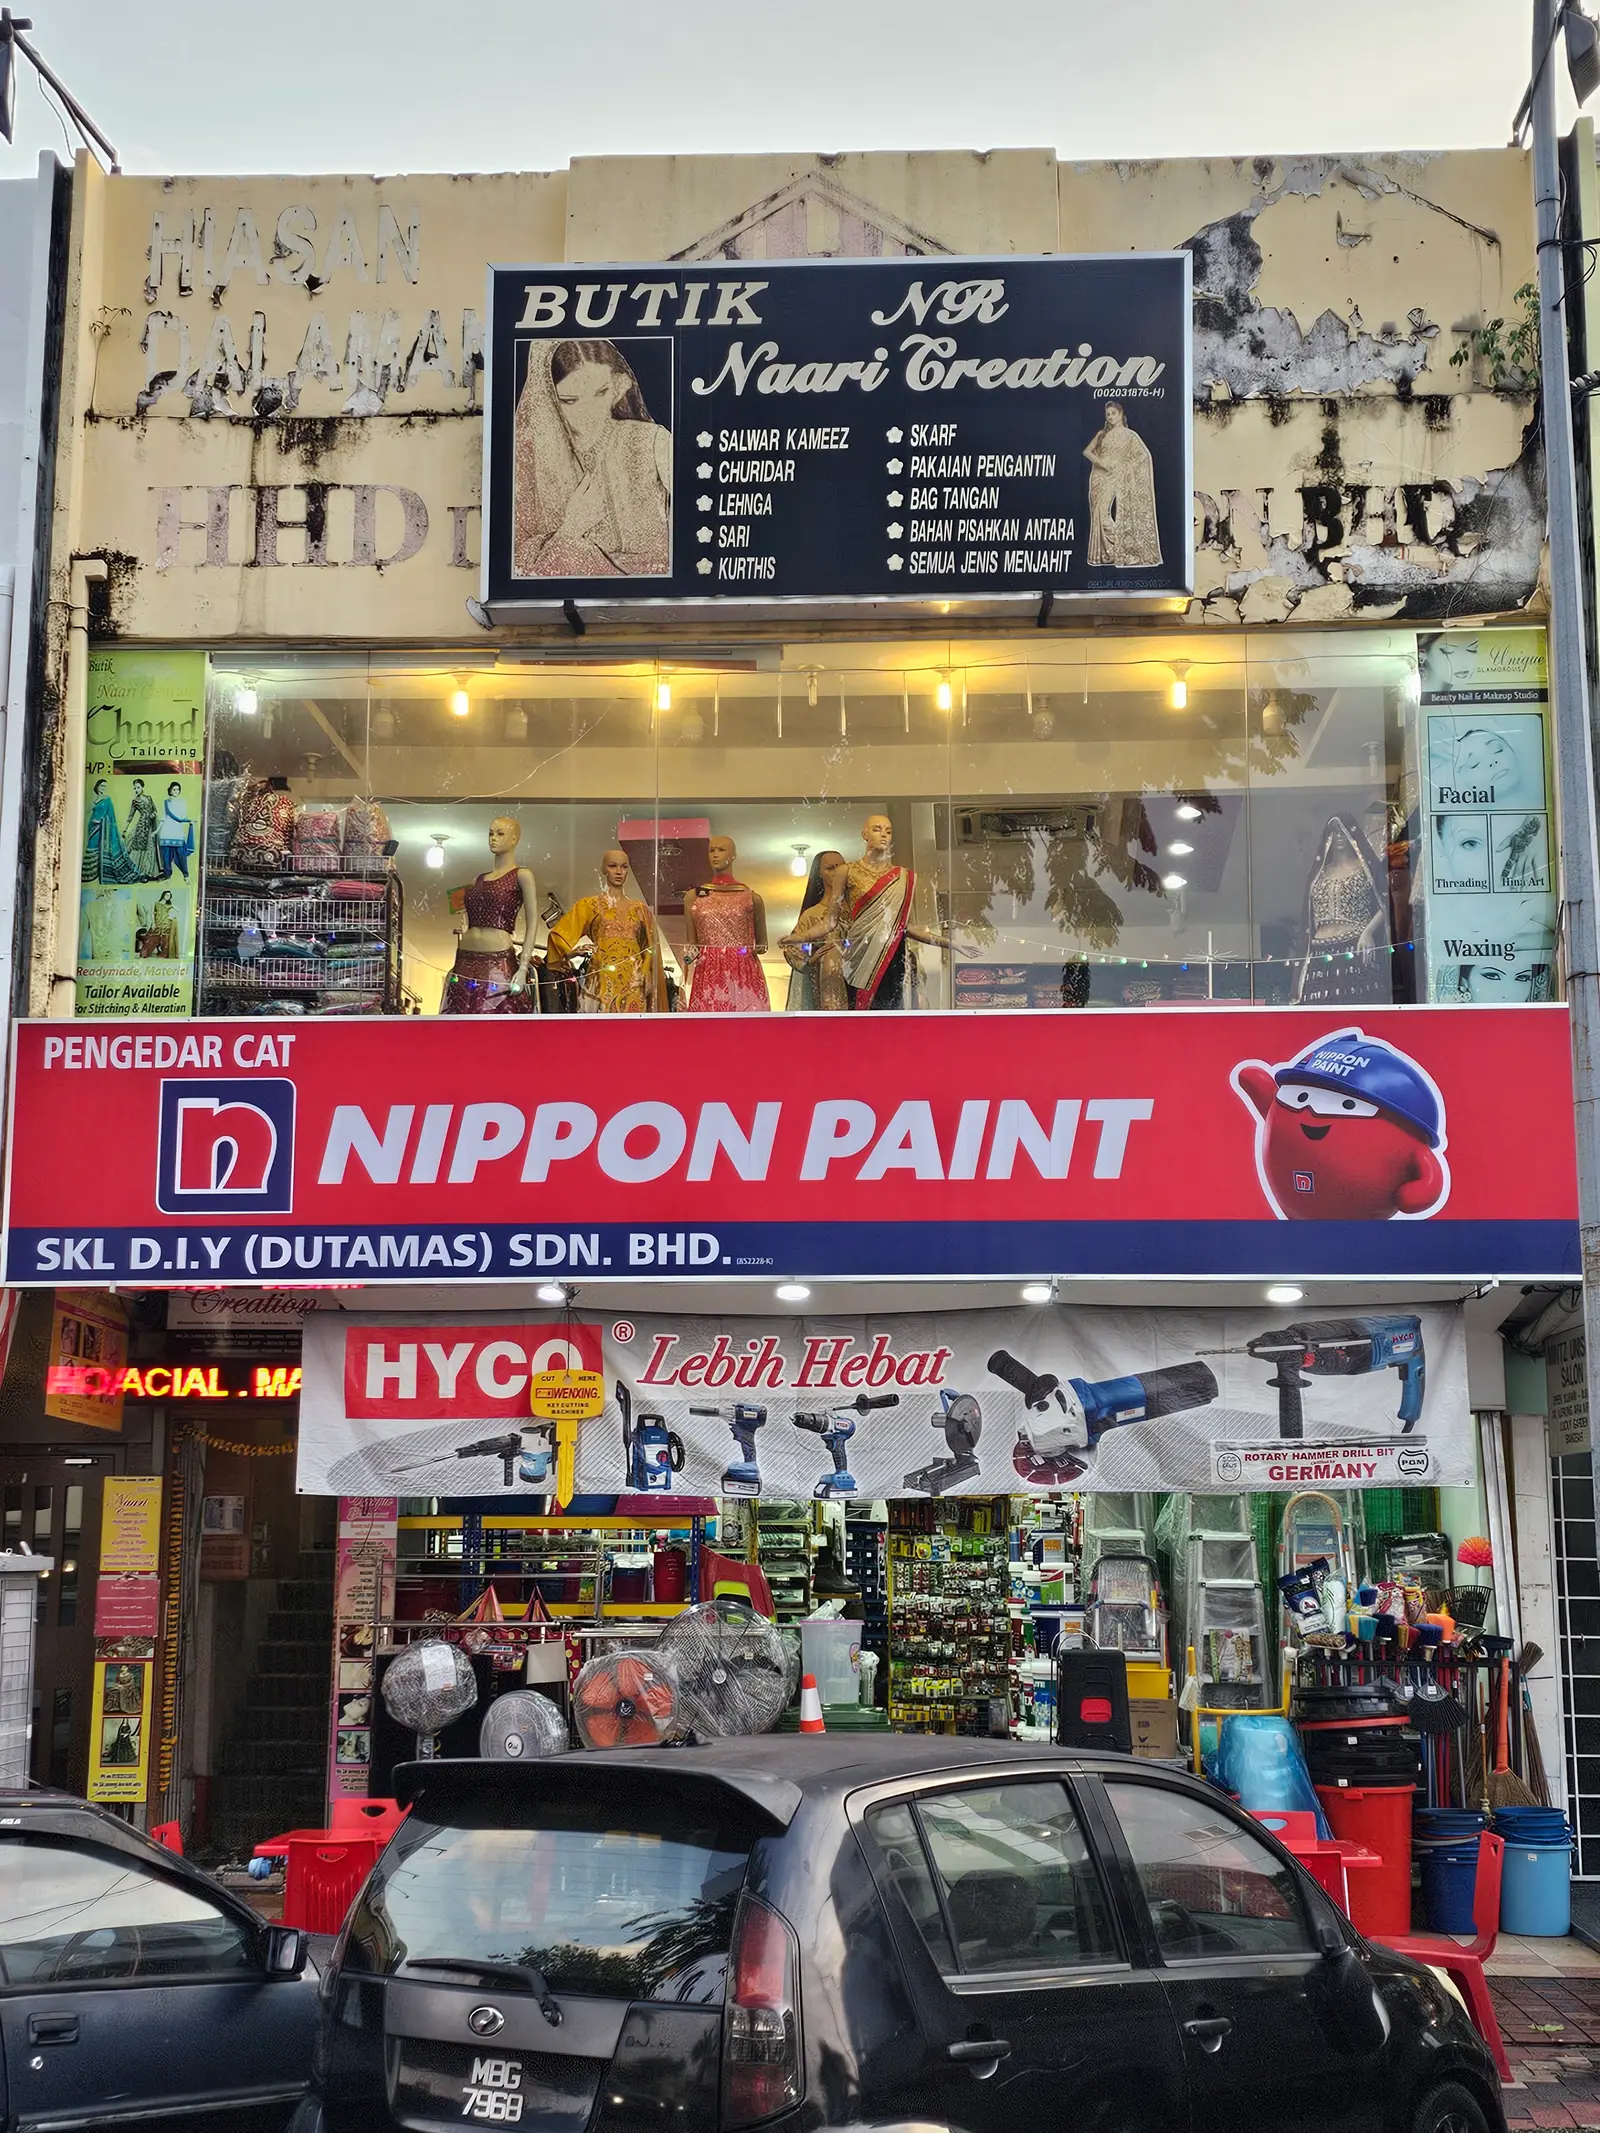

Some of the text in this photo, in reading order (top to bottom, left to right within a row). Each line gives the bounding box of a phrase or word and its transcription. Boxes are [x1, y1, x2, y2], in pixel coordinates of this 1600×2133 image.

[514, 281, 769, 329] BUTIK
[871, 278, 1010, 326] NR
[692, 333, 1166, 396] Naari Creation
[1093, 387, 1165, 399] (002031876-H)
[719, 427, 850, 452] SALWAR KAMEEZ
[910, 424, 957, 447] SKARF
[719, 460, 795, 483] CHURIDAR
[910, 454, 1056, 478] PAKAIAN PENGANTIN
[719, 493, 773, 516] LEHNGA
[910, 487, 999, 510] BAG TANGAN
[719, 525, 750, 548] SARI
[910, 518, 1075, 542] BAHAN PISAHKAN ANTARA
[719, 557, 776, 580] KURTHIS
[909, 550, 1072, 574] SEMUA JENIS MENJAHIT
[1490, 644, 1546, 673] Unique
[1431, 691, 1539, 703] Beauty Nail & Makeup Studio
[131, 746, 197, 758] Tailoring
[1438, 785, 1496, 804] Facial
[1435, 878, 1488, 890] Threading
[1528, 877, 1545, 887] Art
[1443, 939, 1516, 961] Waxing
[85, 984, 180, 999] Tailor Available
[88, 1003, 130, 1016] Stitching
[132, 1003, 140, 1013] &
[44, 1035, 296, 1069] PENGEDAR CAT
[1314, 1050, 1371, 1068] NIPPON
[1311, 1059, 1355, 1077] PAINT
[317, 1098, 1155, 1185] NIPPON PAINT
[36, 1237, 115, 1270] SKL
[129, 1236, 231, 1270] D.I.Y
[244, 1231, 494, 1275] (DUTAMAS)
[508, 1233, 612, 1267] SDN.
[628, 1232, 732, 1266] BHD.
[637, 1335, 952, 1389] Lebih Hebat
[1244, 1448, 1395, 1462] ROTARY HAMMER DRILL BIT
[1401, 1459, 1426, 1467] PGM
[1268, 1462, 1378, 1482] GERMANY
[471, 2057, 523, 2089] MBG
[462, 2087, 524, 2122] 7968
